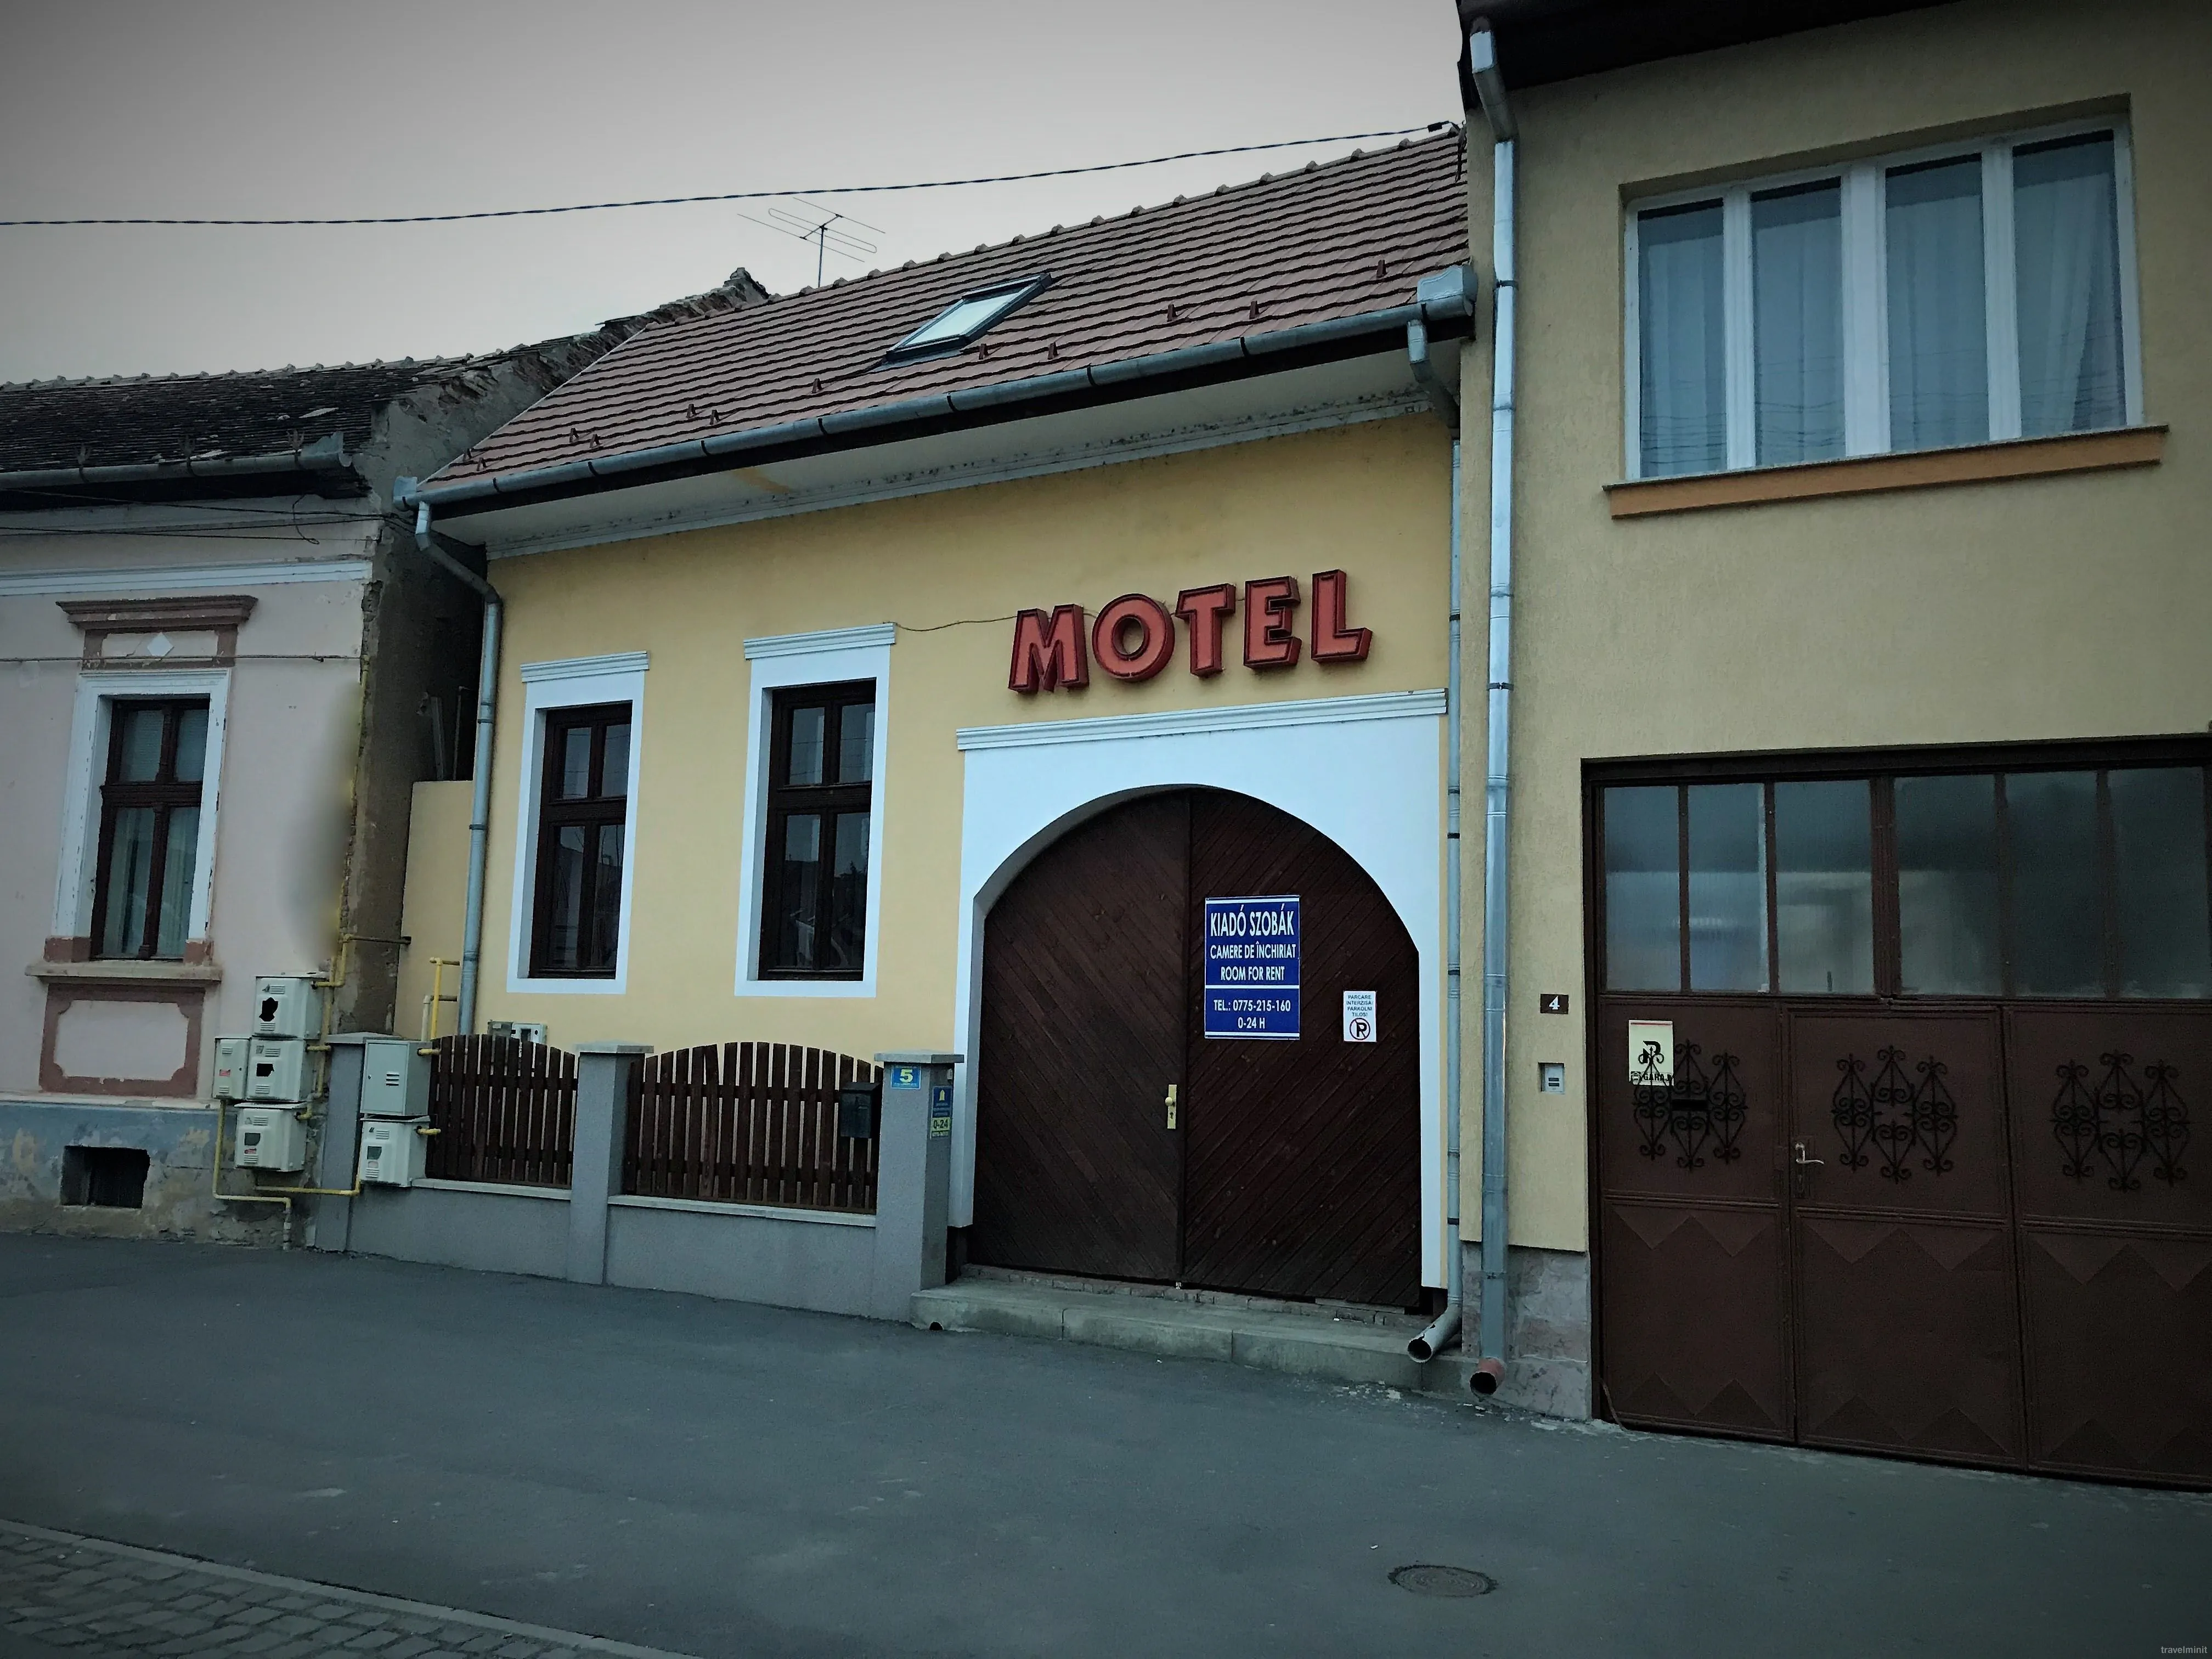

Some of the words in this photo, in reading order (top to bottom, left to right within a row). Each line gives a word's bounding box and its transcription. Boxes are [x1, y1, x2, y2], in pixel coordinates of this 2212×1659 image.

[1008, 569, 1374, 695] MOTEL
[1210, 905, 1246, 936] KIADÓ
[1250, 903, 1294, 936] SZOBÁK
[1210, 945, 1243, 959] CAMERE
[1244, 944, 1255, 958] DE
[1256, 941, 1296, 958] ÎNCHIRIAT
[1221, 966, 1246, 980] ROOM
[1248, 966, 1264, 980] FOR
[1266, 966, 1285, 980] RENT
[1214, 1000, 1231, 1011] TEL.:
[1233, 1000, 1291, 1012] 0775-215-160
[1549, 996, 1560, 1010] 4
[1238, 1017, 1257, 1029] 0-24
[1259, 1017, 1265, 1029] H
[900, 1069, 913, 1082] 5
[933, 1119, 948, 1128] 0-24
